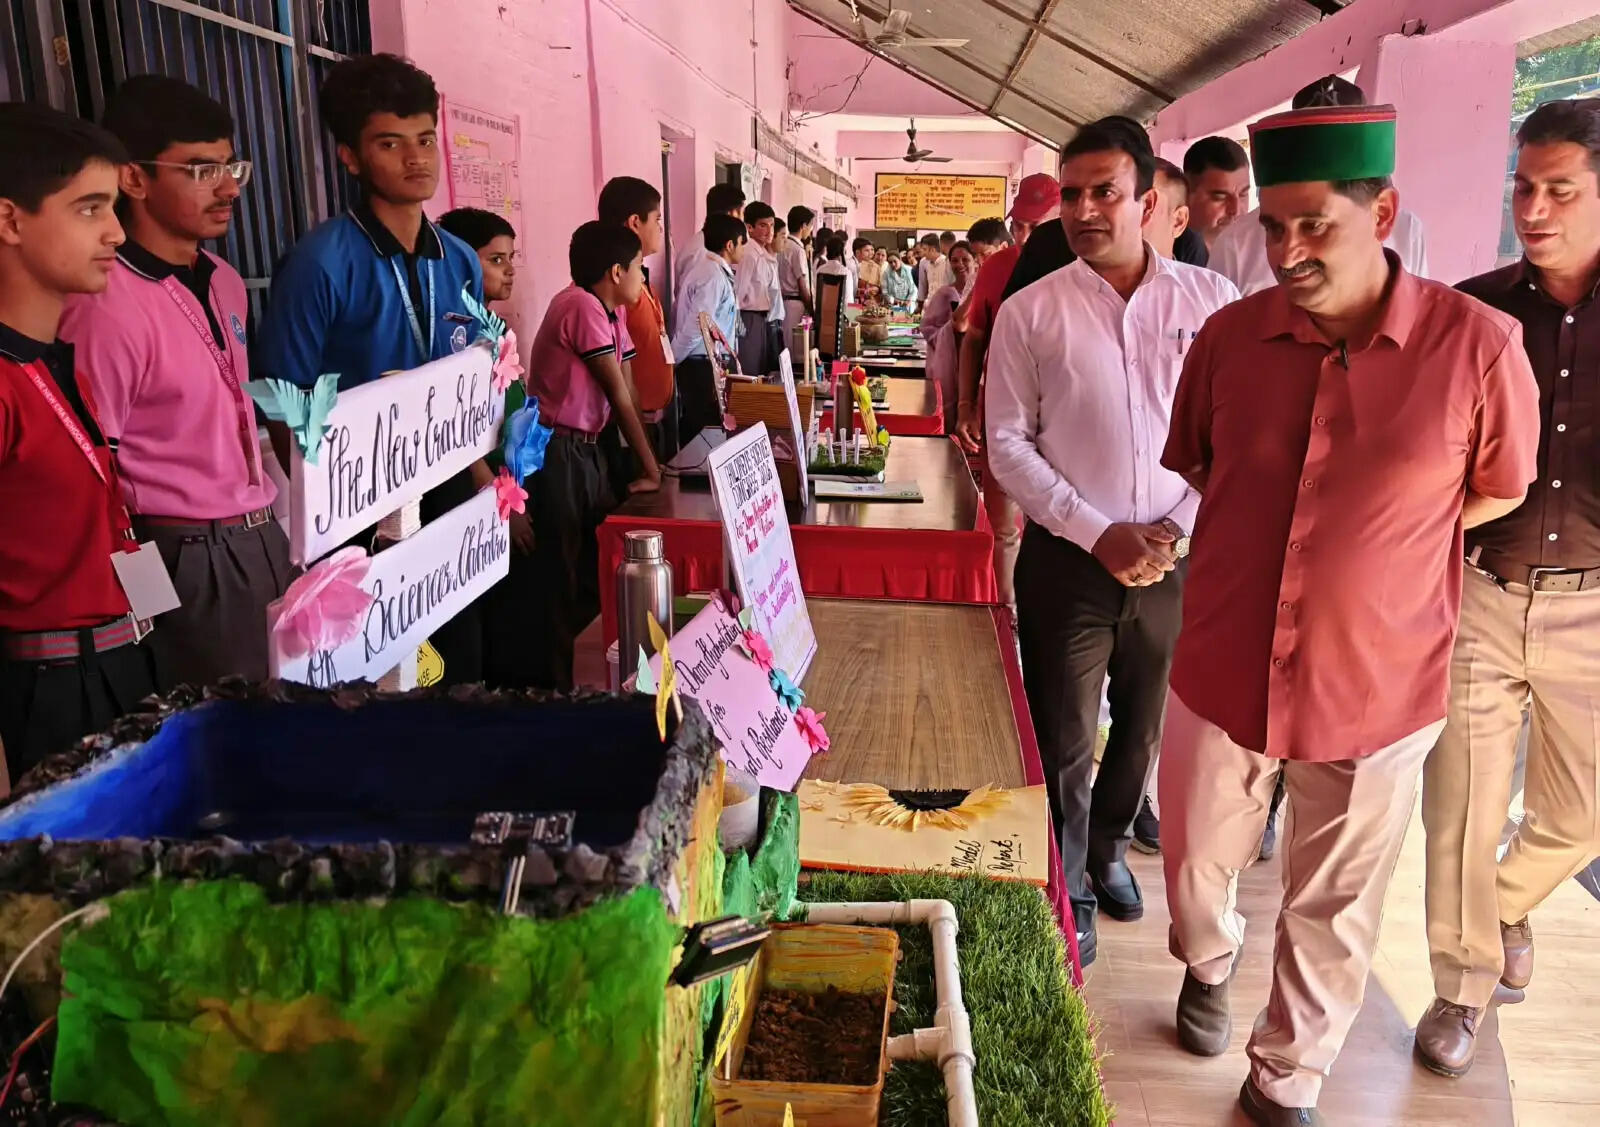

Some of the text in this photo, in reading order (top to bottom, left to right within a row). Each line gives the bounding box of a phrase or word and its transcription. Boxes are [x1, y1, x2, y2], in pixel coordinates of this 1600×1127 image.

[191, 314, 207, 337] SCHOOL
[54, 402, 66, 418] ERA
[63, 416, 86, 445] SCHOOL
[314, 366, 497, 535] The New Era School
[731, 470, 760, 510] CONGRESS
[362, 561, 451, 664] Sciences
[706, 698, 732, 741] for
[950, 839, 982, 871] Model
